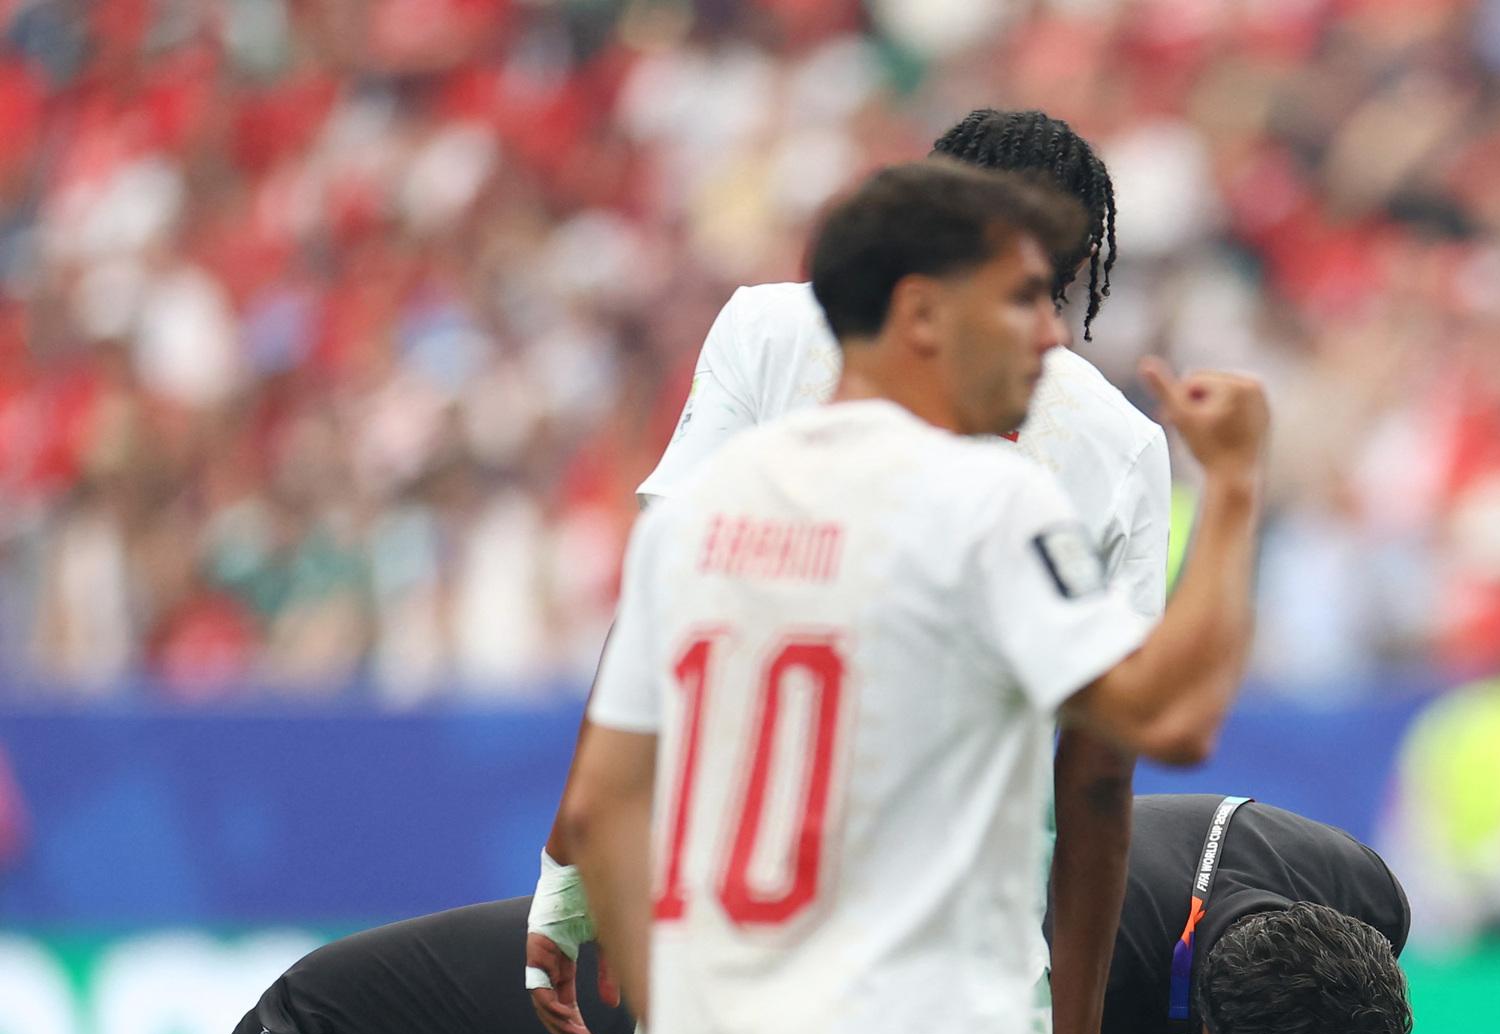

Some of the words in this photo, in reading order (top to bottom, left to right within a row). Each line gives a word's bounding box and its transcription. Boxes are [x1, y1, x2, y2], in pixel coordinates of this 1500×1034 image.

[652, 630, 852, 926] 10
[1209, 825, 1223, 841] CUP
[1201, 841, 1219, 873] WORLD
[1196, 872, 1211, 893] FIFA
